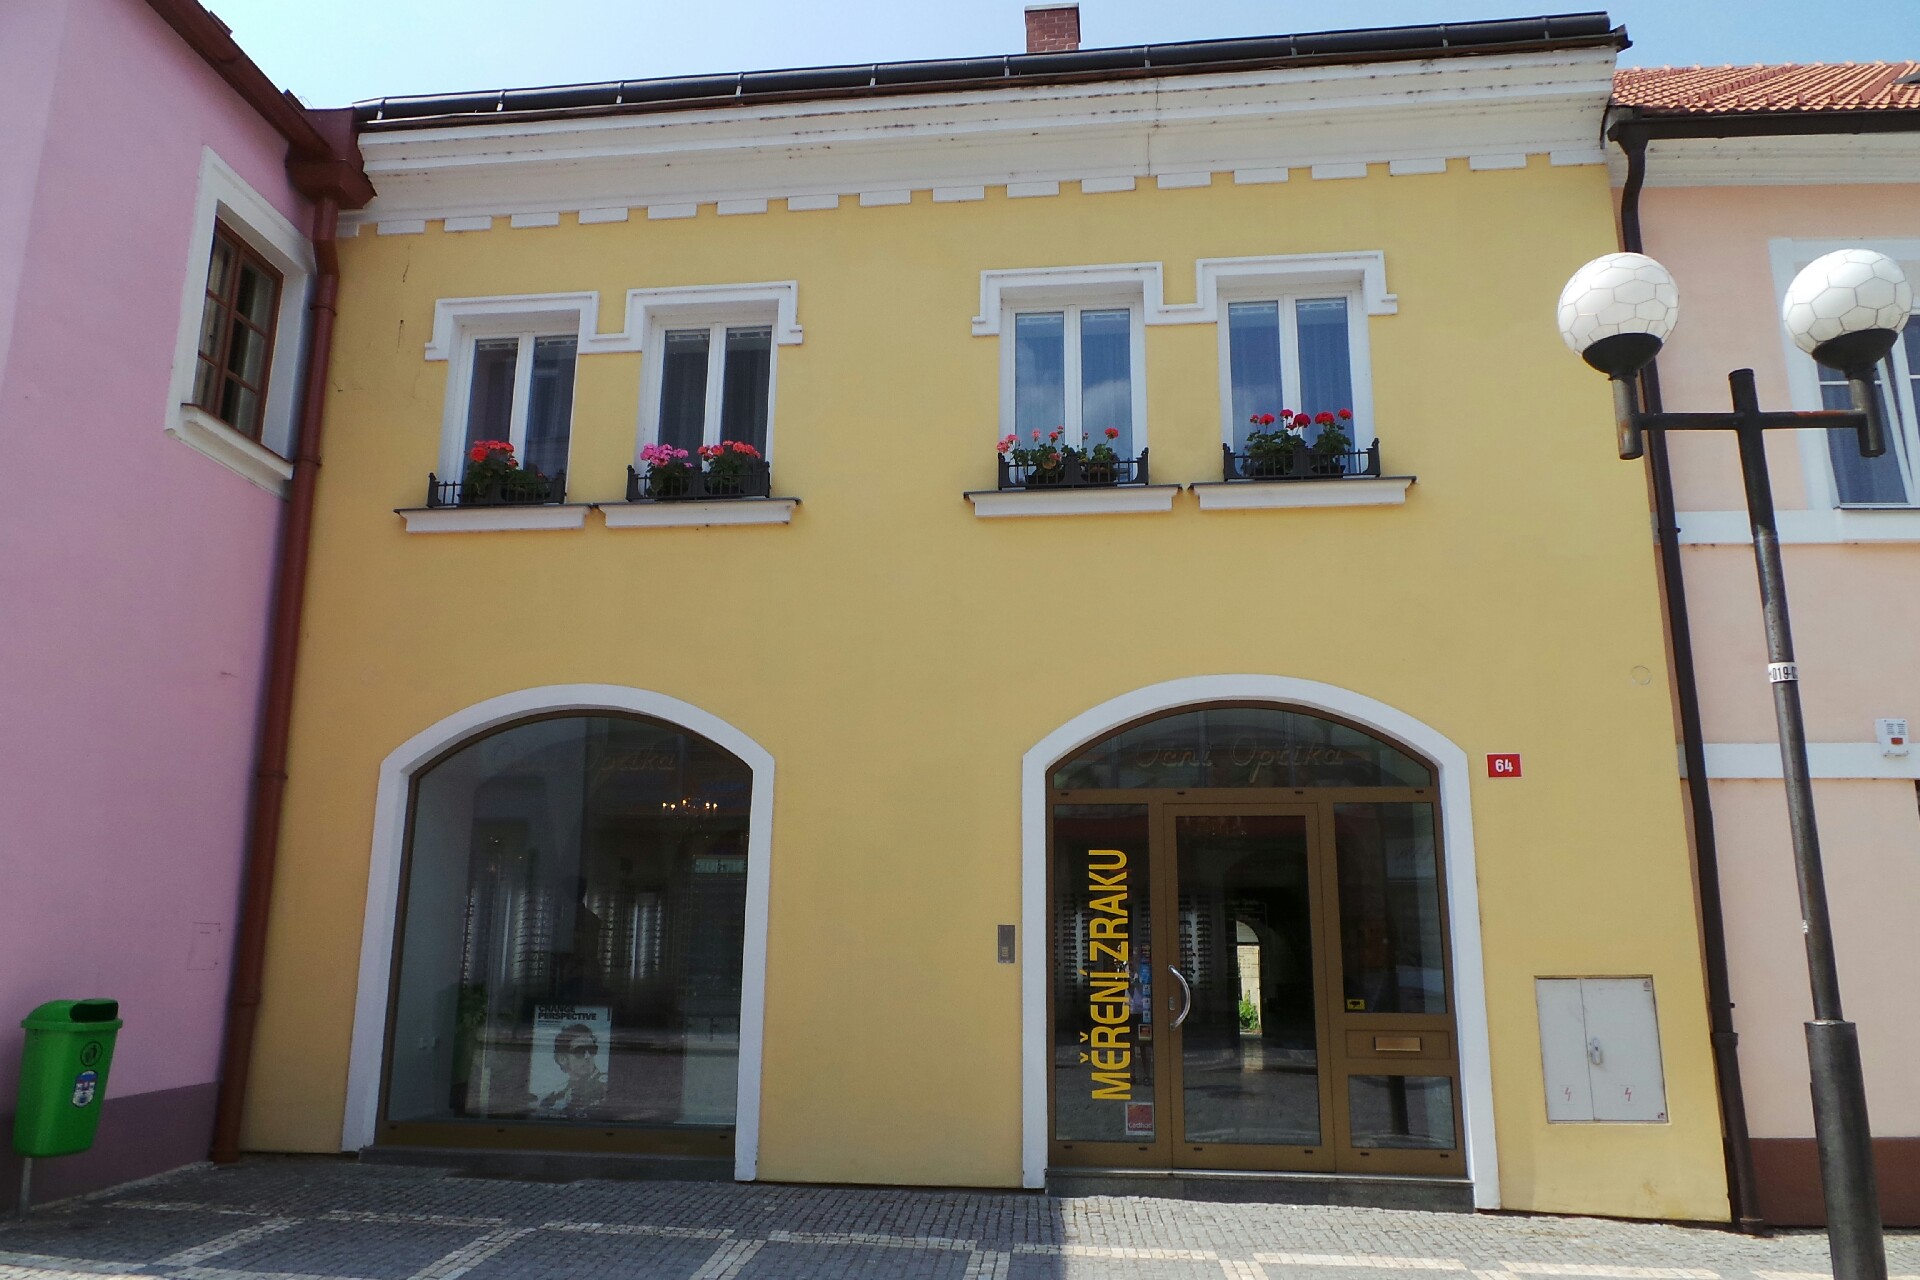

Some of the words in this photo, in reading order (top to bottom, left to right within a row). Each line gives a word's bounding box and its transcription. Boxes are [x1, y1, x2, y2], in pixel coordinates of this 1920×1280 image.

[1231, 735, 1345, 783] Optika
[1495, 758, 1514, 773] 64
[1088, 849, 1129, 961] ZRAKU
[538, 1012, 597, 1020] PERSPECTIVE
[1080, 969, 1131, 1100] MĚŘENÍ
